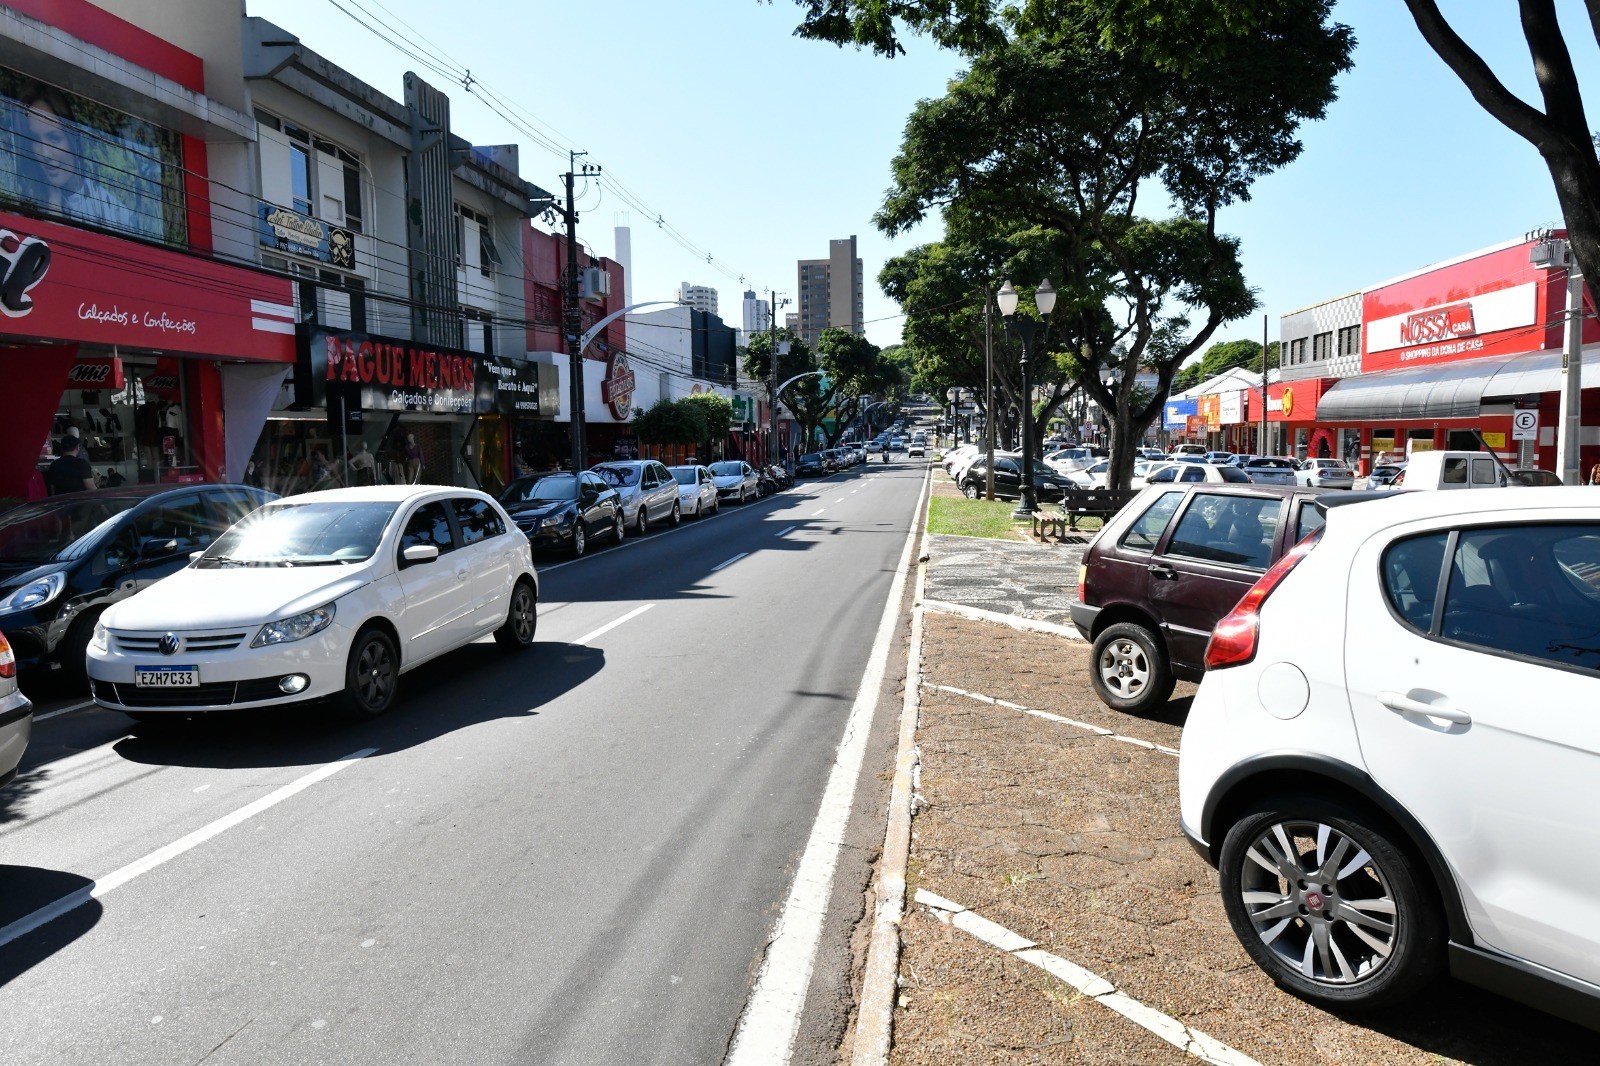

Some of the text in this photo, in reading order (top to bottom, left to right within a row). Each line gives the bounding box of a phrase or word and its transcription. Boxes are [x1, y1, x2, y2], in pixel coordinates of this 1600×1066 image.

[78, 302, 196, 334] Calçados e Confecções
[1400, 310, 1472, 346] NOSSA CASA
[1405, 346, 1431, 361] SHOPPING
[1431, 344, 1440, 357] DA
[1440, 342, 1457, 356] DONA
[1457, 340, 1466, 354] DE
[1466, 338, 1484, 352] CASA
[325, 336, 474, 391] PAGUE MENOS
[498, 379, 517, 392] Barato
[391, 389, 472, 410] Calçados e Confecções
[1522, 416, 1530, 426] E
[141, 672, 193, 685] EZH7C33
